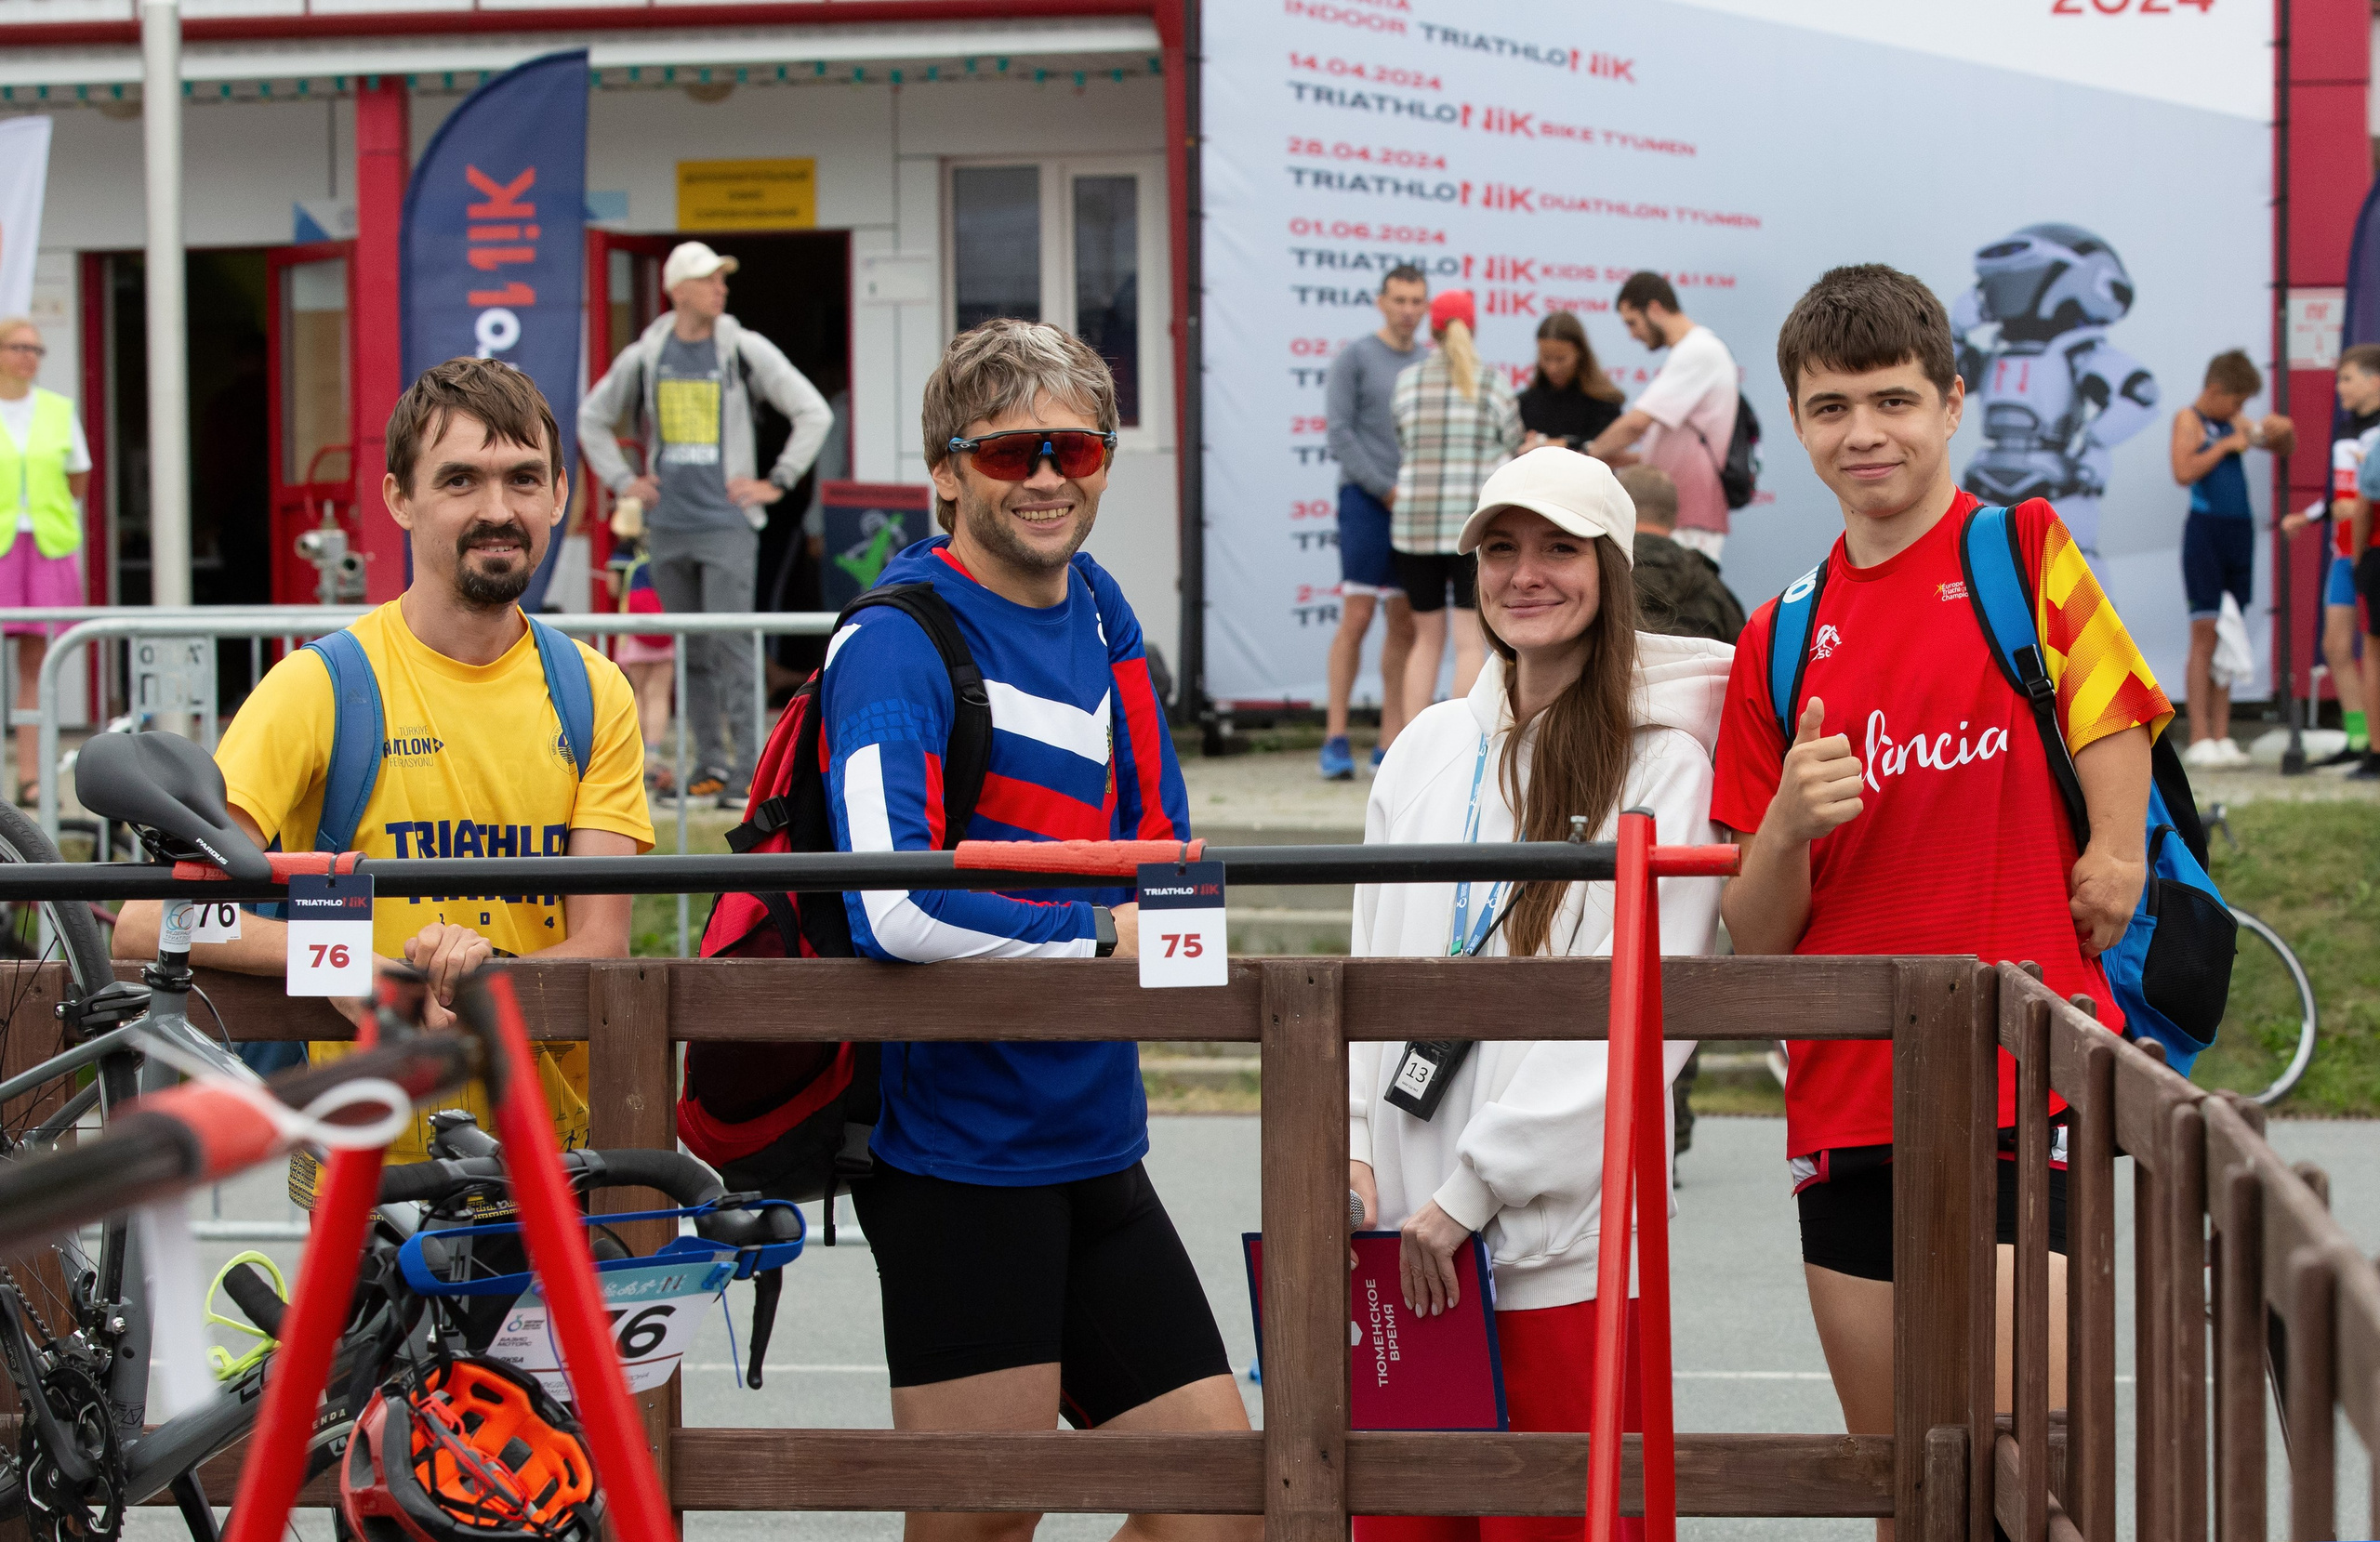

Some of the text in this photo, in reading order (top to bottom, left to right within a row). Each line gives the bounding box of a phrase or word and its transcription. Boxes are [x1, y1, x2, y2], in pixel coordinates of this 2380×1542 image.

[1288, 52, 1443, 91] 14.04.2024
[1540, 122, 1593, 144] BIKE
[1287, 137, 1448, 171] 28.04.2024
[1539, 193, 1670, 220] DUATHLON
[1289, 217, 1447, 245] 01.06.2024
[1540, 264, 1597, 283] KIDS
[1942, 581, 1964, 590] Europe
[195, 837, 229, 865] PARDUS
[198, 903, 236, 928] 76
[309, 943, 350, 969] 76
[1161, 933, 1204, 959] 75
[1406, 1061, 1429, 1084] 13
[1366, 1279, 1389, 1388] ТЮМЕНСКОЕ
[1383, 1304, 1400, 1362] ВРЕМЯ
